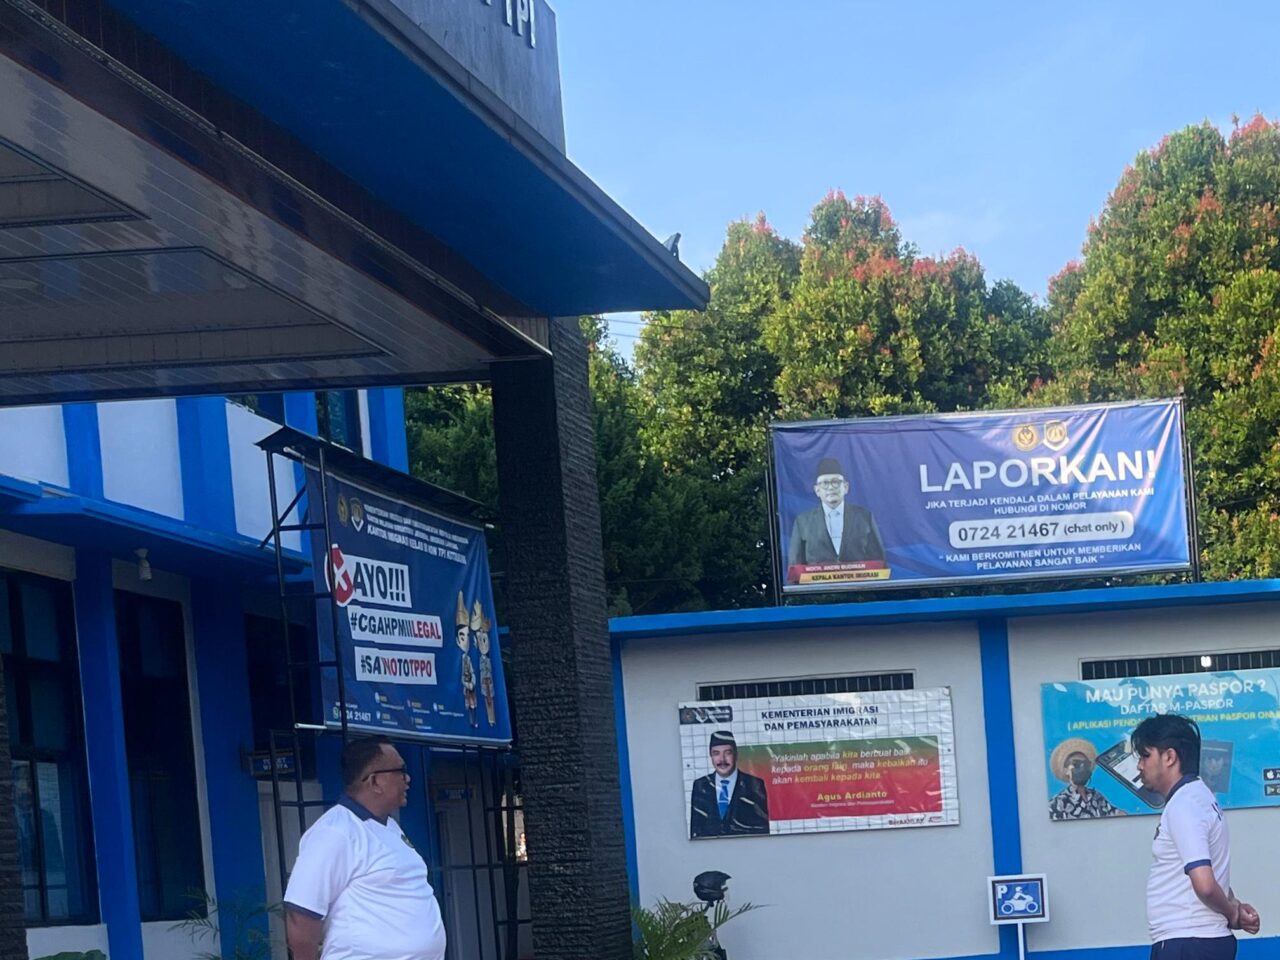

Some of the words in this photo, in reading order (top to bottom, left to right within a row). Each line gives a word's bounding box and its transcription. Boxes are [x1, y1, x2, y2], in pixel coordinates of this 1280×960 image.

[919, 449, 1156, 493] LAPORKAN!
[925, 500, 947, 510] JIKA
[948, 497, 988, 508] TERJADI
[990, 495, 1035, 506] KENDALA
[1037, 493, 1071, 503] DALAM
[1072, 490, 1128, 500] PELAYANAN
[1130, 487, 1154, 498] KAMI
[994, 504, 1038, 515] HUBUNGI
[1039, 503, 1049, 513] DI
[1051, 501, 1087, 512] NOMOR
[958, 525, 1001, 542] 0724
[1006, 522, 1059, 539] 21467
[1063, 521, 1092, 535] (chat
[1095, 520, 1118, 533] only
[946, 553, 970, 562] KAMI
[972, 549, 1042, 561] BERKOMITMEN
[1044, 547, 1076, 557] UNTUK
[1078, 543, 1141, 555] MEMBERIKAN
[977, 559, 1032, 570] PELAYANAN
[1034, 557, 1073, 567] SANGAT
[1075, 555, 1098, 565] BAIK
[353, 562, 406, 602] AYO!!!
[1085, 688, 1124, 703] MAU
[1128, 684, 1184, 702] PUNYA
[1188, 680, 1253, 697] PASPOR
[761, 708, 831, 719] KEMENTERIAN
[1120, 703, 1167, 715] DAFTAR
[1170, 699, 1234, 713] M-PASPOR
[764, 723, 784, 731] DAN
[787, 717, 878, 730] PEMASYARAKATAN
[817, 792, 841, 802] Agus
[845, 791, 888, 800] Ardianto
[997, 885, 1008, 899] P
